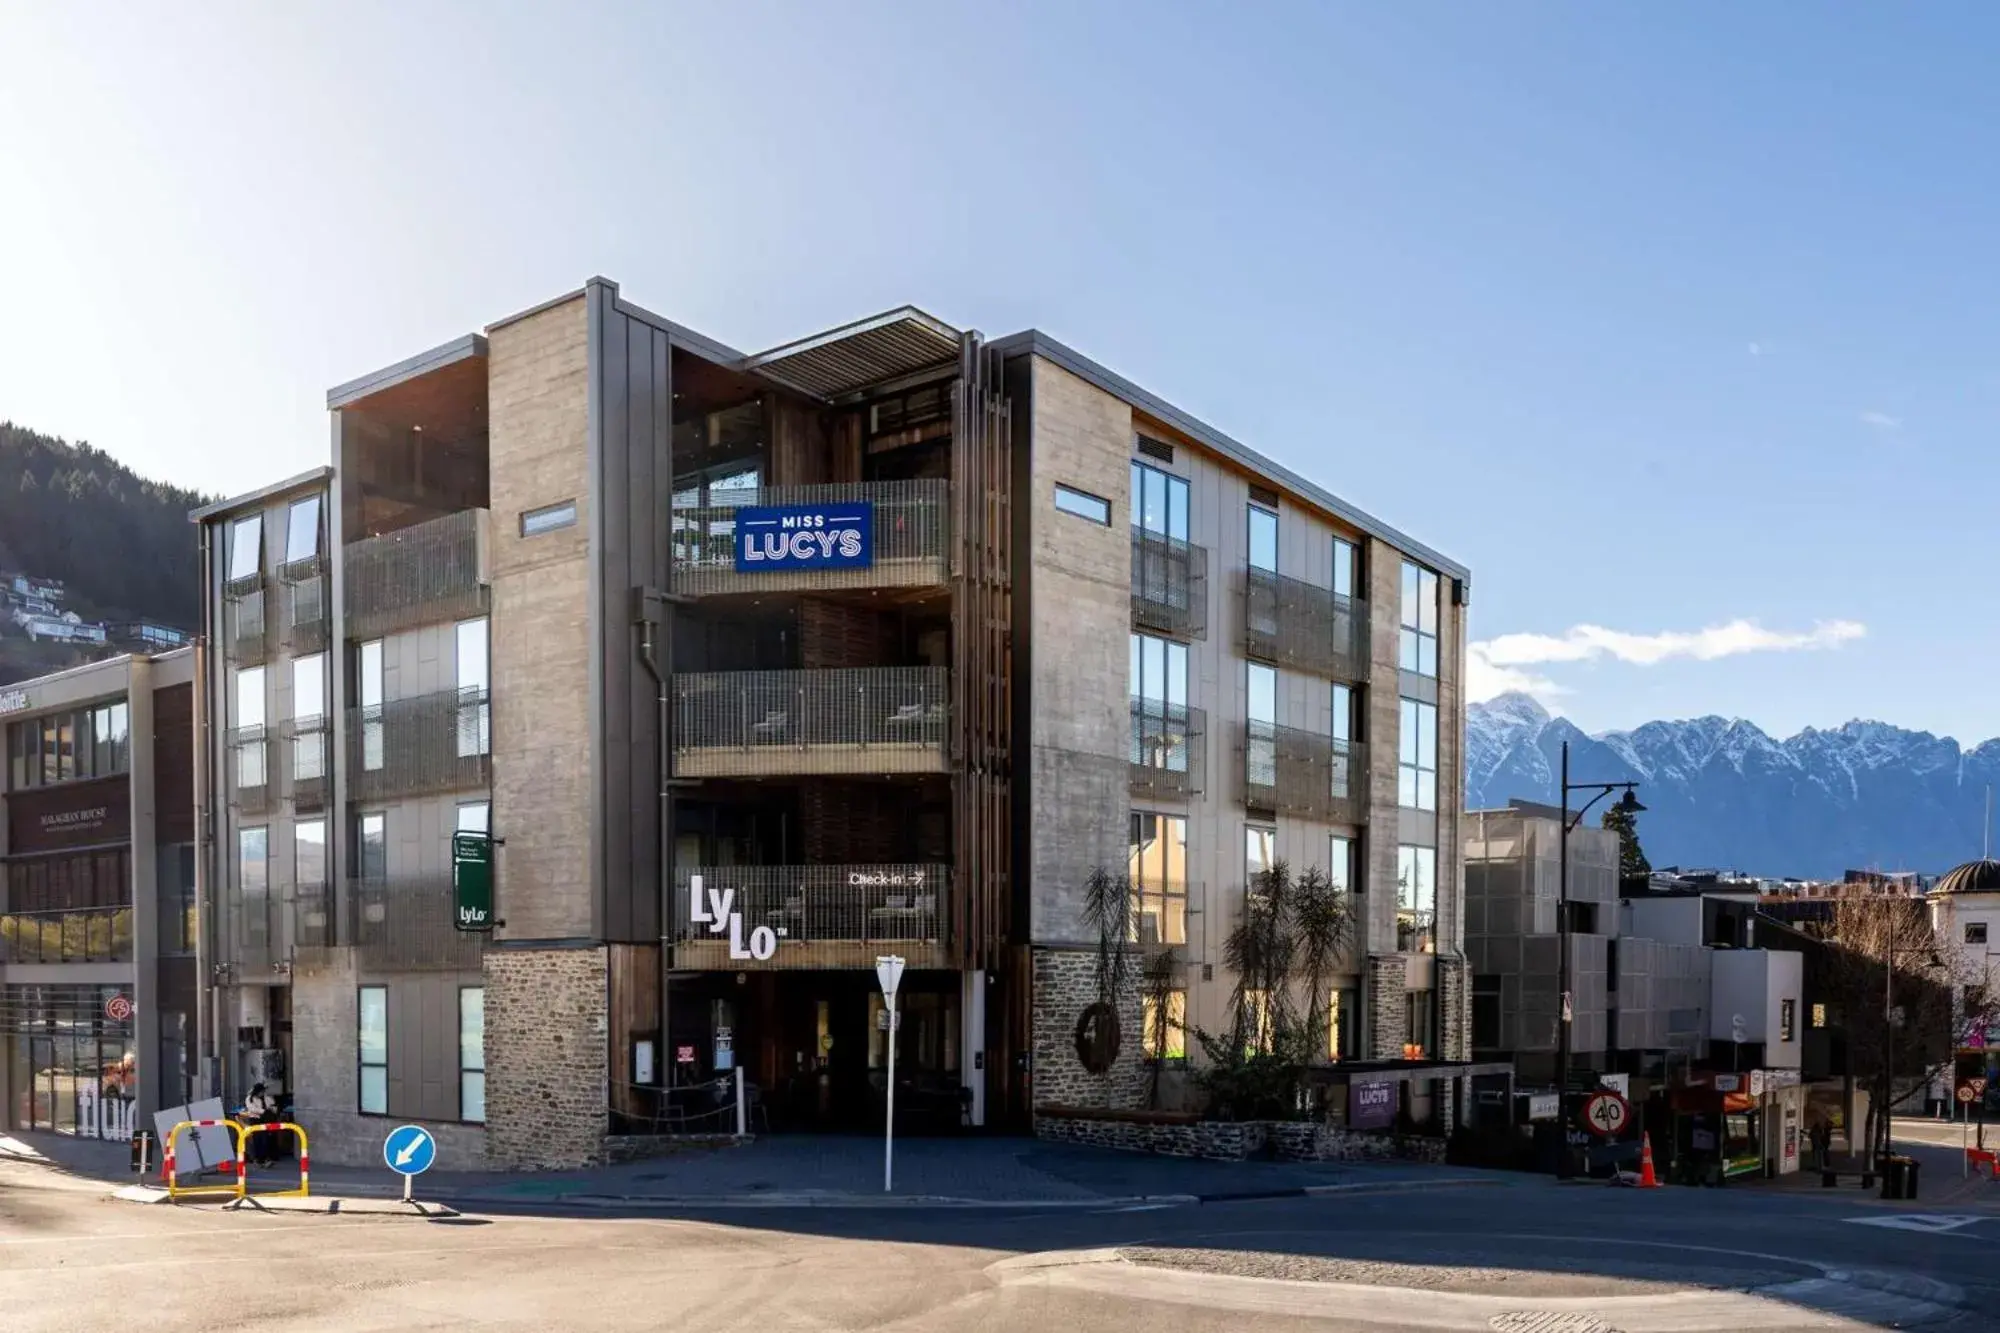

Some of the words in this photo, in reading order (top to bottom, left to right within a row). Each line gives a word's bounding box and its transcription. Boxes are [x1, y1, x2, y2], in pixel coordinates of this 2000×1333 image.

[782, 515, 824, 528] MISS
[744, 529, 862, 561] LUCYS
[849, 872, 902, 886] Check-in
[1594, 1103, 1620, 1122] 40
